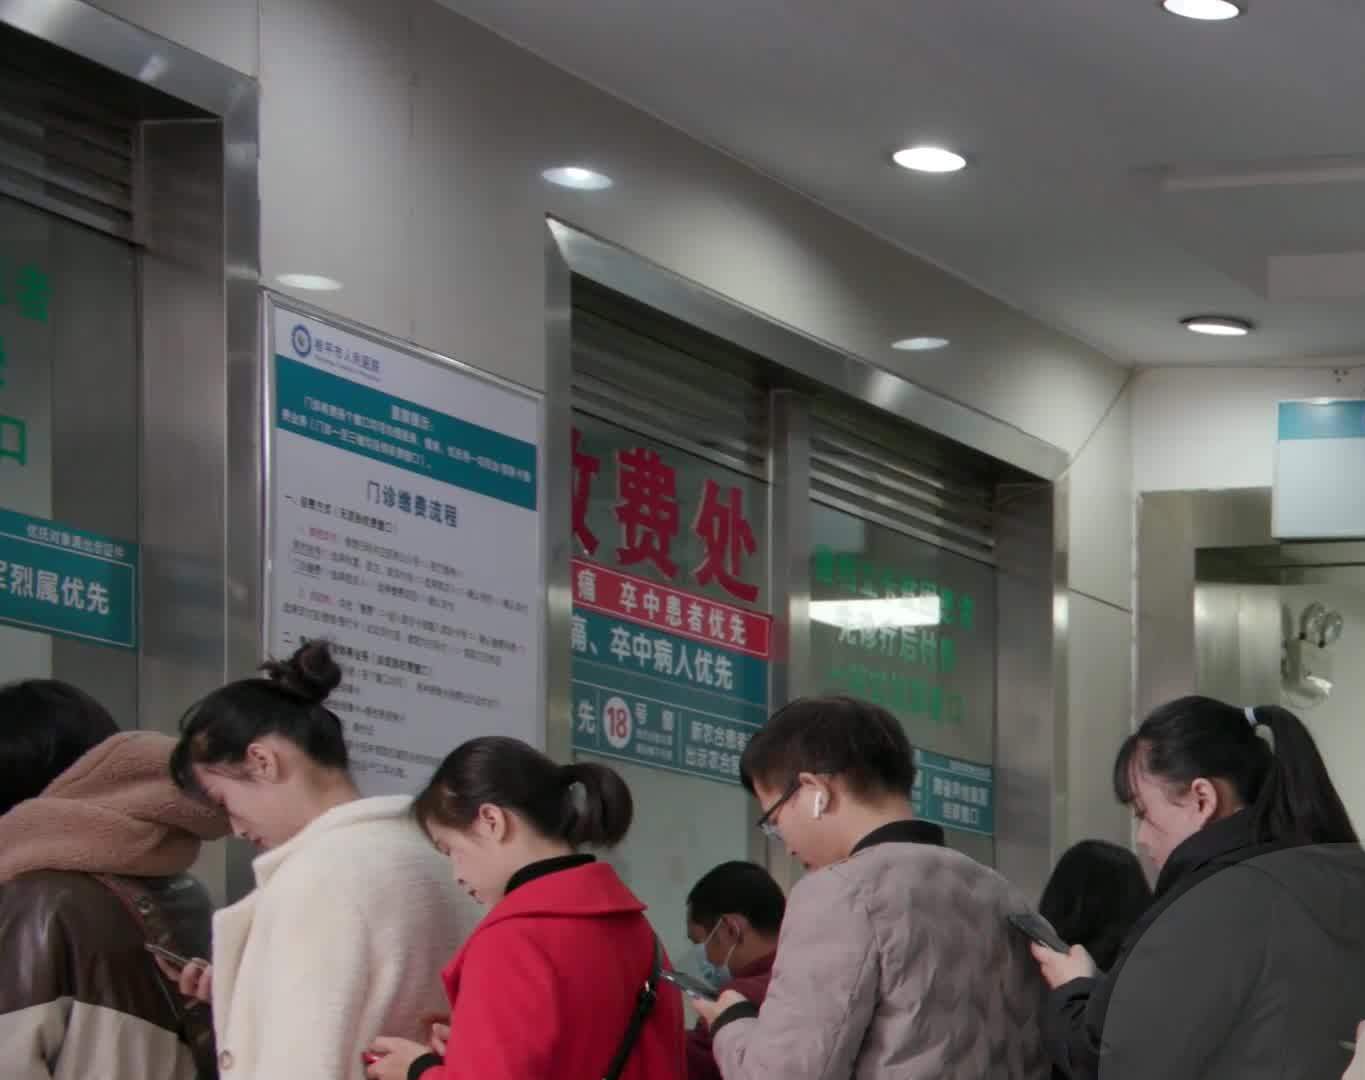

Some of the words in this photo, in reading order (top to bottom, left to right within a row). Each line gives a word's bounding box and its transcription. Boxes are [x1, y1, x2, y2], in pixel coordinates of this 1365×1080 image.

[619, 579, 748, 648] 卒中患者优先
[606, 707, 628, 740] 18
